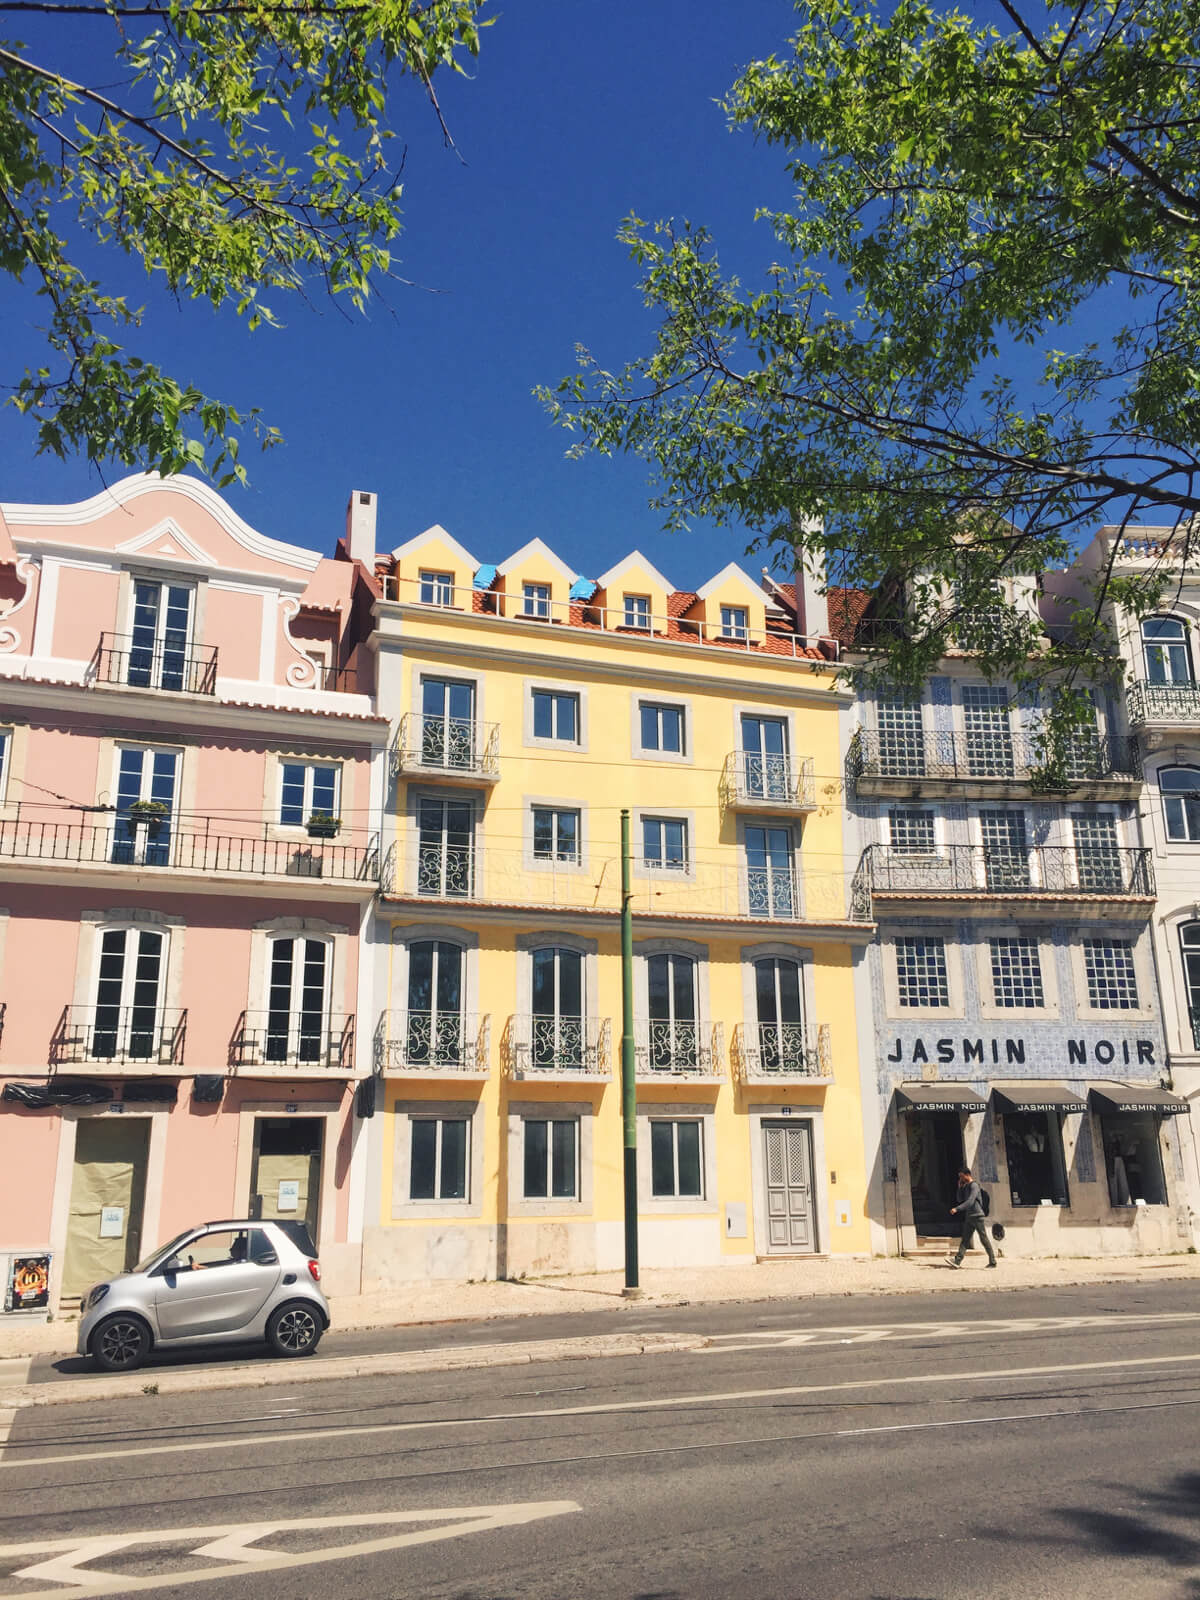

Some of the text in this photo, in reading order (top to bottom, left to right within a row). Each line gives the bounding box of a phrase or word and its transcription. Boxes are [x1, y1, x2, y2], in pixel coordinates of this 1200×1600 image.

[887, 1038, 1156, 1065] JASMIN NOIR
[916, 1103, 955, 1111] JASMIN
[961, 1103, 986, 1111] NOIR
[1017, 1103, 1088, 1112] JASMIN NOIR
[1119, 1104, 1188, 1112] JASMIN NOIR
